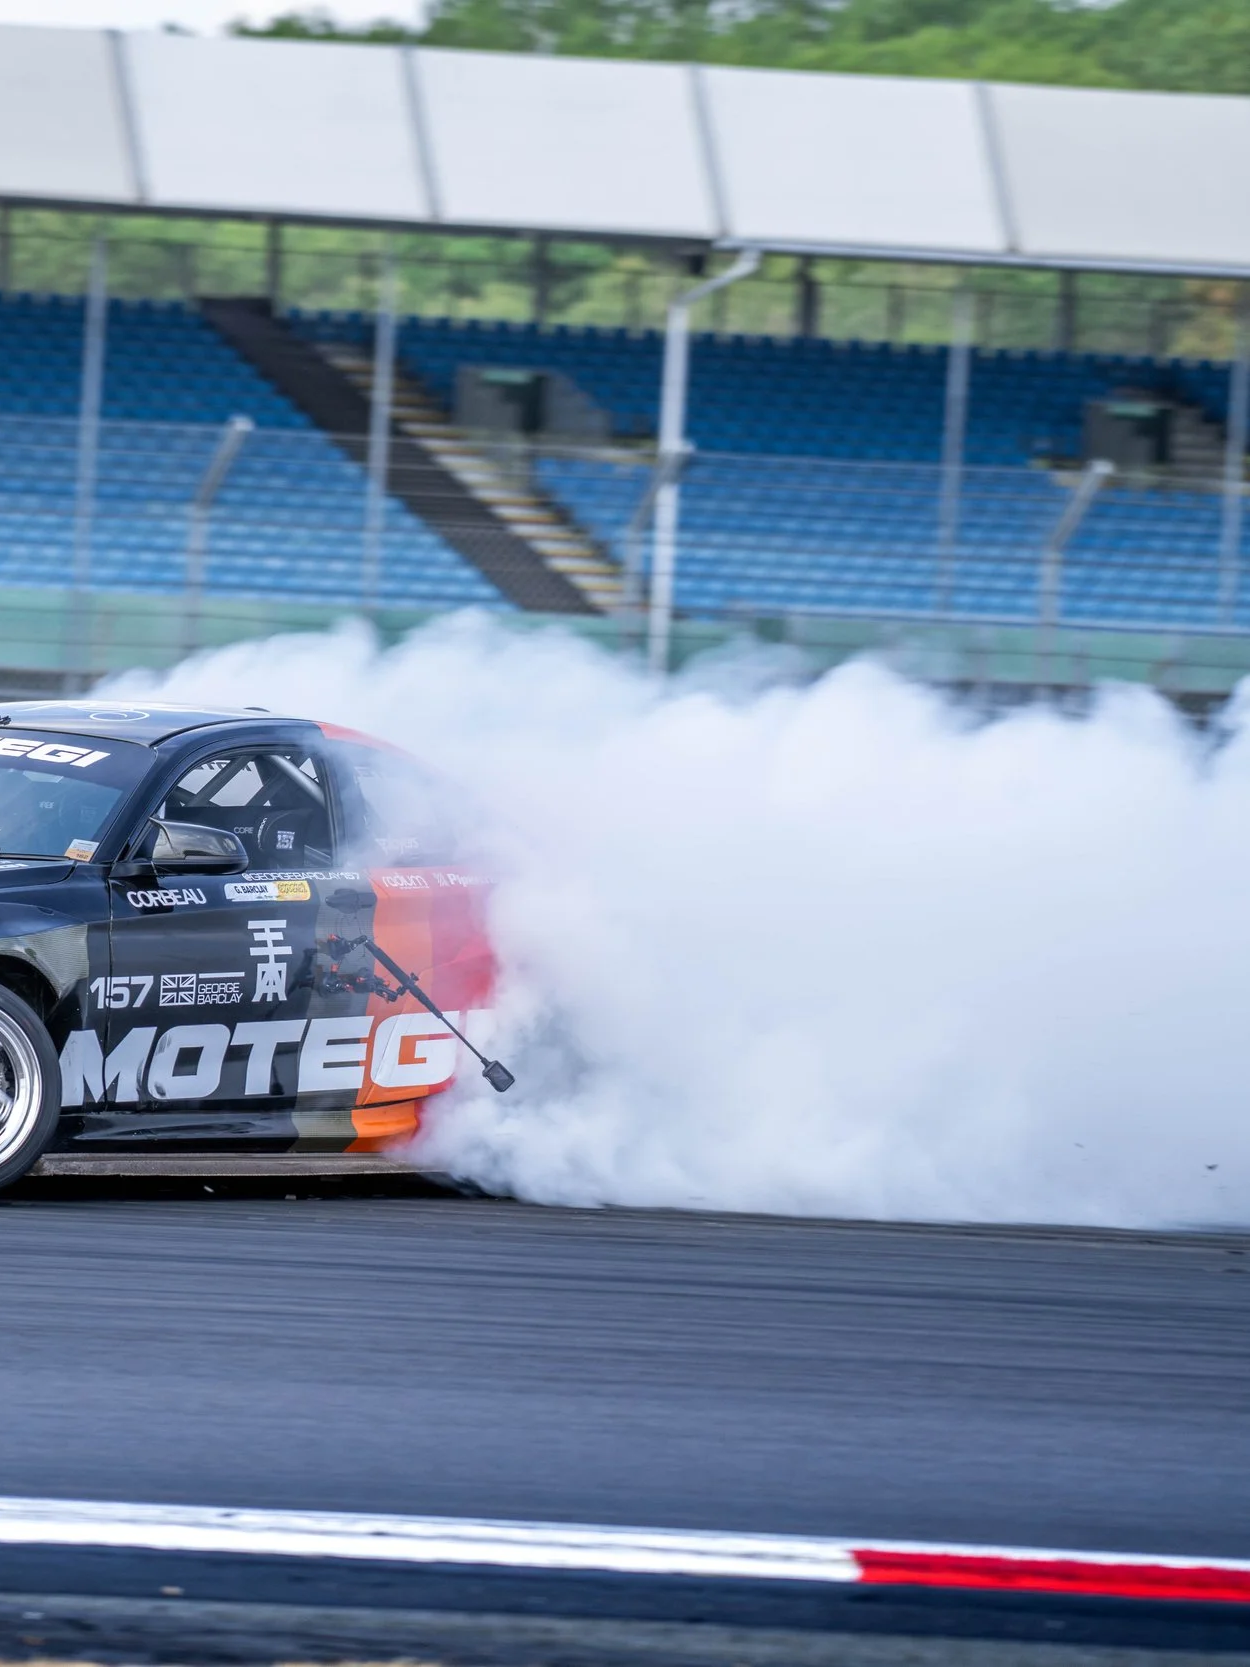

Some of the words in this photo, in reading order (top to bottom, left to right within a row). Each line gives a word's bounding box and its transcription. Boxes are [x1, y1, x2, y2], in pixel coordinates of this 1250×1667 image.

[243, 884, 269, 894] BARCLAY
[127, 888, 206, 908] CORBEAU
[89, 975, 154, 1009] 157
[197, 982, 240, 994] GEORGE
[197, 993, 243, 1005] BARCLAY
